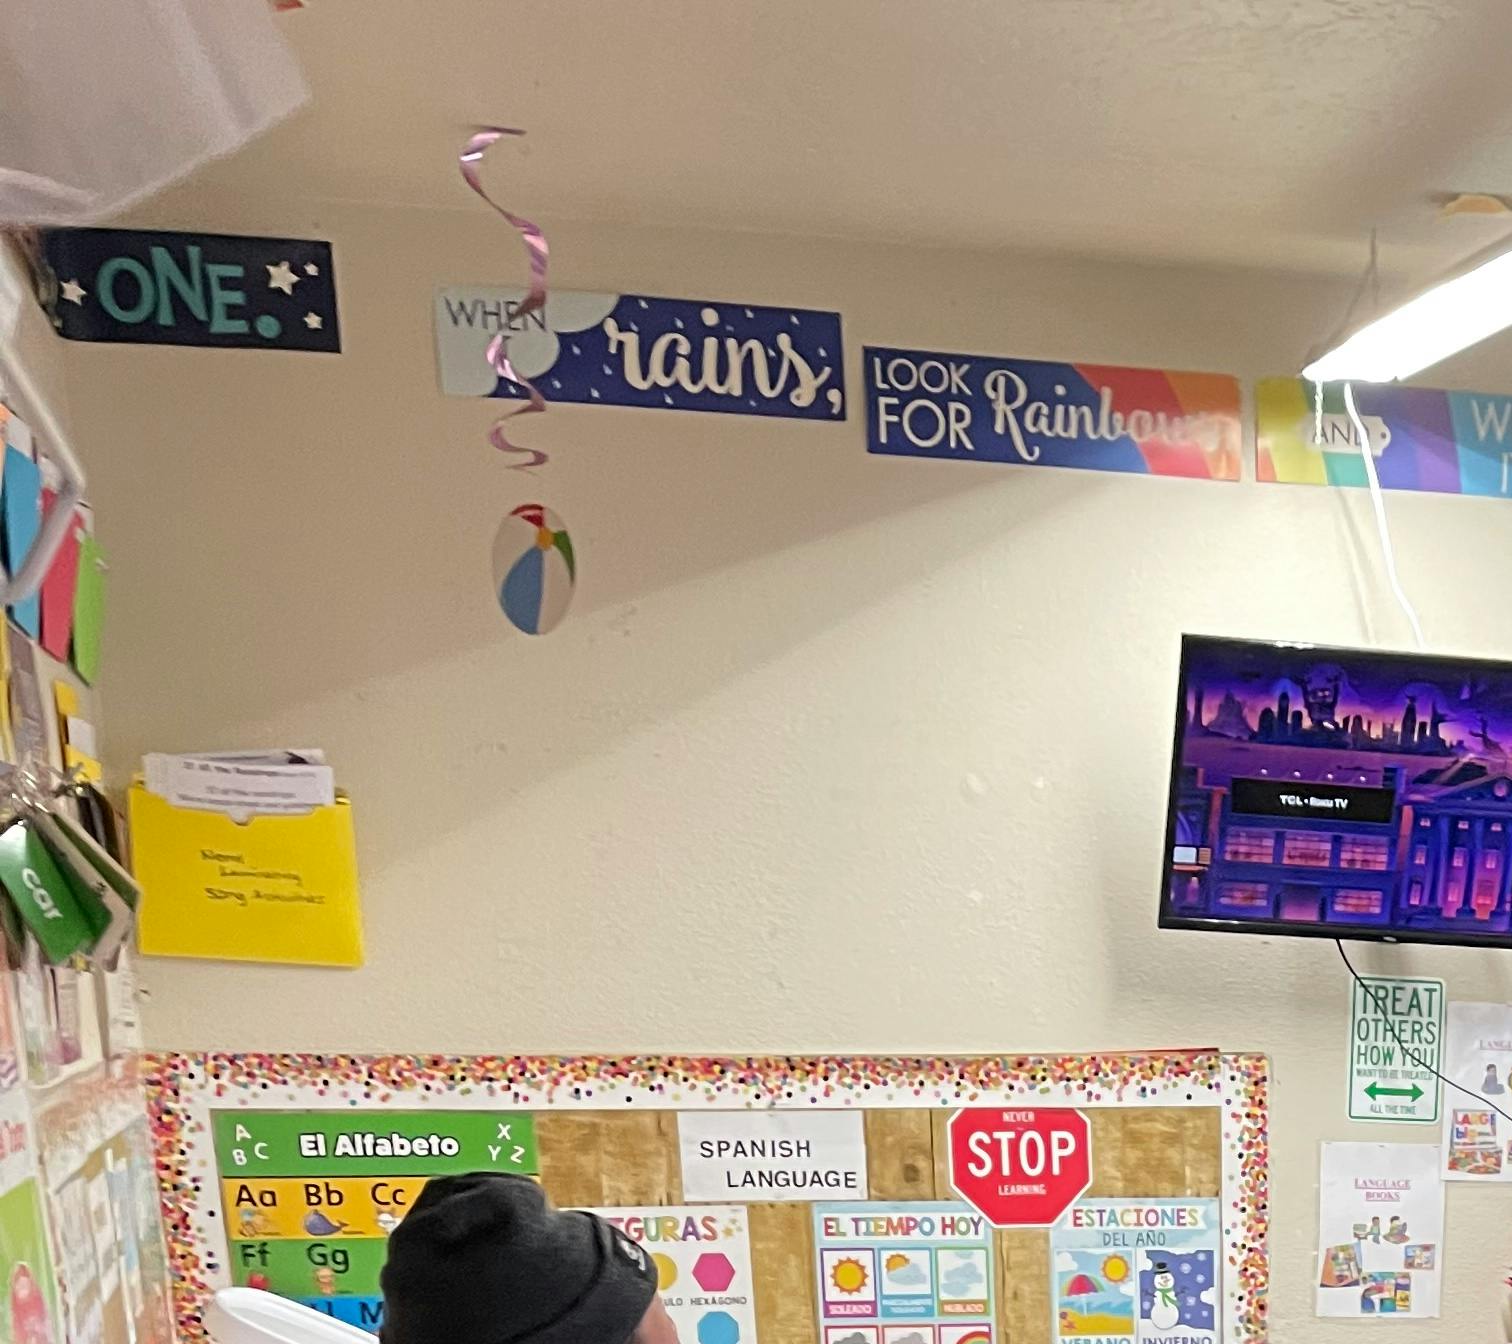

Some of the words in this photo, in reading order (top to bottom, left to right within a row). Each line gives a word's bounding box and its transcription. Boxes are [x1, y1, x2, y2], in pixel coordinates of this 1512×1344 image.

[97, 245, 283, 340] ONE.
[444, 296, 547, 333] WHEN
[603, 307, 842, 415] rains,
[873, 357, 973, 396] LOOK
[878, 396, 975, 451] FOR
[983, 368, 1240, 462] Rainbo
[1279, 794, 1303, 806] TCL
[1334, 798, 1349, 810] TV
[1359, 984, 1438, 1018] TREAT
[1356, 1017, 1437, 1045] OTHERS
[1356, 1045, 1396, 1067] HOW
[1400, 1047, 1435, 1069] YOU
[1002, 1111, 1035, 1123] NEVER
[235, 1123, 252, 1142] A
[497, 1123, 512, 1141] X
[232, 1149, 247, 1166] B
[254, 1142, 269, 1160] C
[299, 1132, 327, 1157] El
[335, 1132, 460, 1158] Alfabeto
[488, 1145, 502, 1162] Y
[510, 1146, 526, 1164] Z
[699, 1140, 811, 1158] SPANISH
[967, 1130, 1076, 1177] STOP
[726, 1170, 857, 1189] LANGUAGE
[998, 1184, 1046, 1196] LEARNING
[1354, 1178, 1411, 1189] LANGUAGE
[235, 1184, 277, 1207] Aa
[304, 1182, 344, 1207] Bb
[371, 1182, 407, 1206] Cc
[1365, 1190, 1401, 1201] BOOKS
[823, 1216, 847, 1237] EL
[851, 1215, 936, 1237] TIEMPO
[941, 1215, 984, 1237] HOY
[1072, 1207, 1199, 1228] ESTACIONES
[1102, 1231, 1129, 1247] DEL
[1135, 1229, 1166, 1247] AÑO
[241, 1242, 269, 1268] Ff
[306, 1242, 350, 1274] Gg
